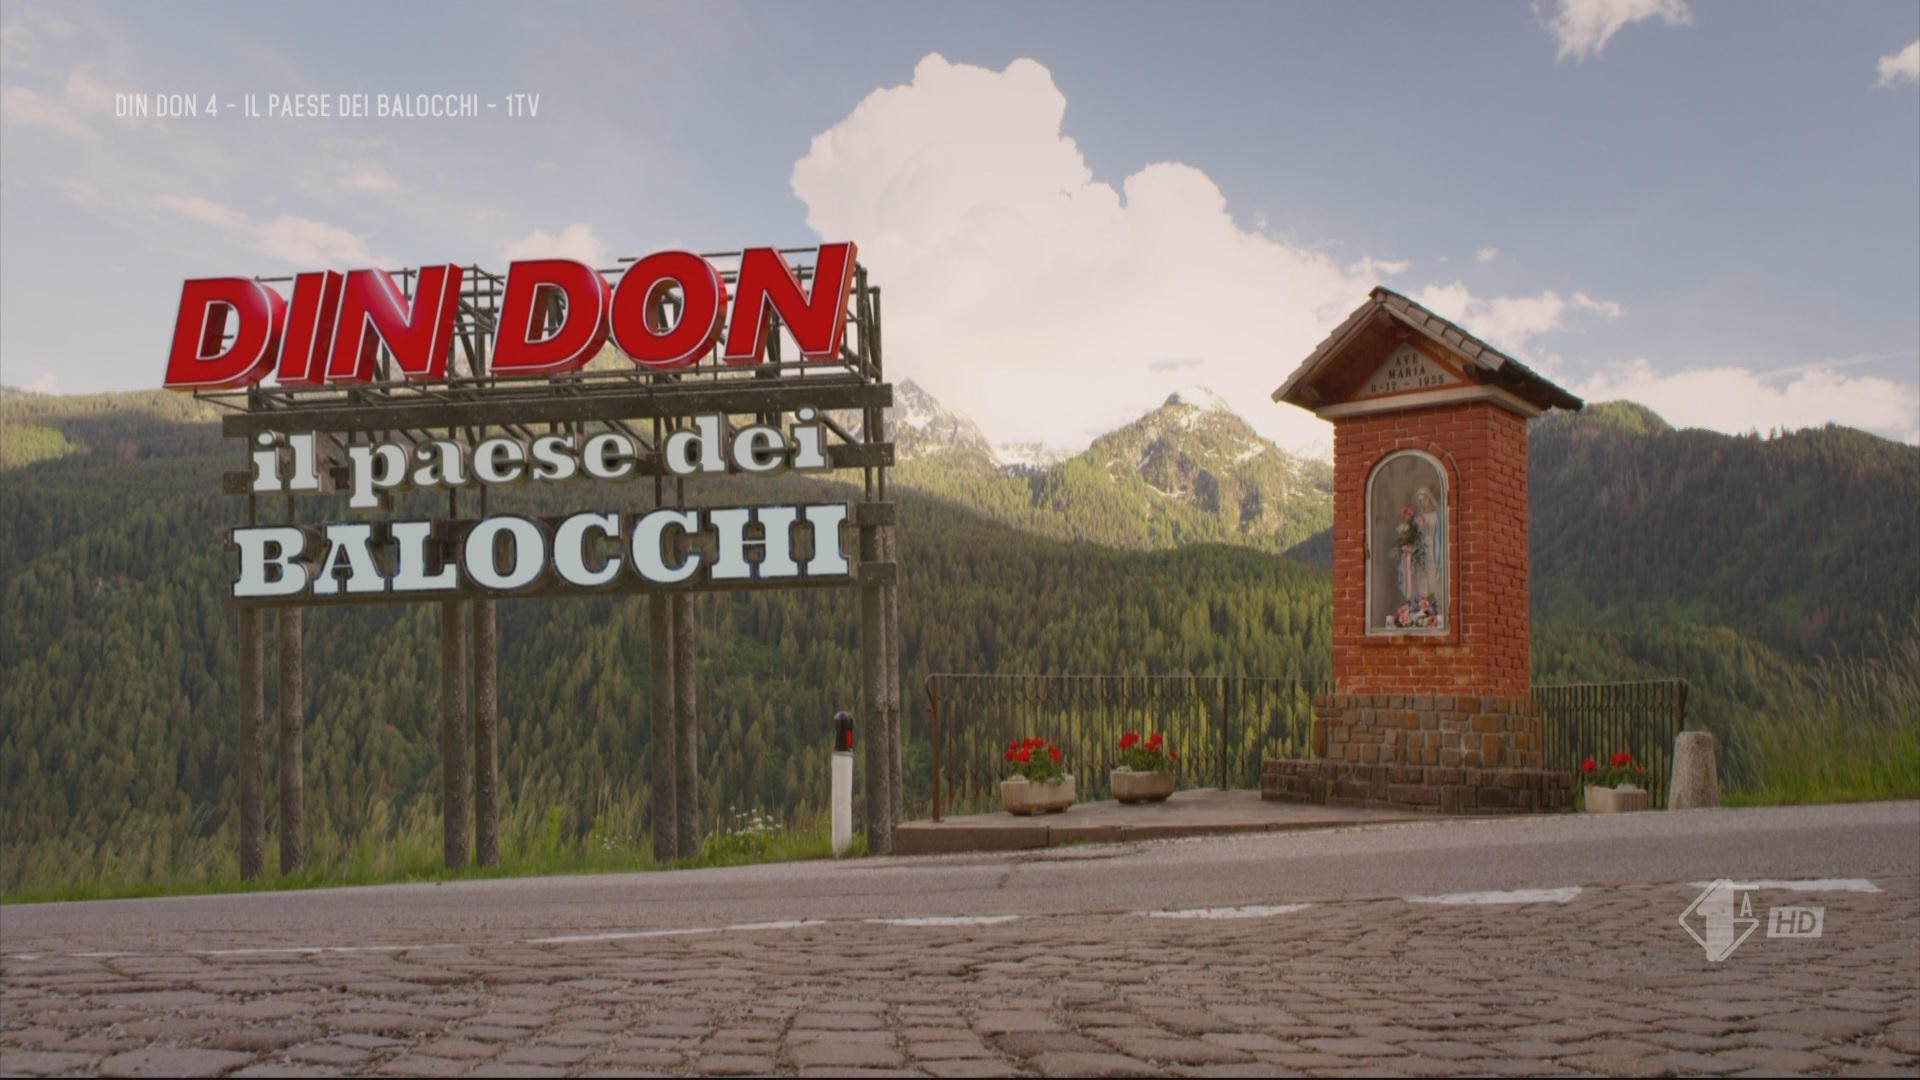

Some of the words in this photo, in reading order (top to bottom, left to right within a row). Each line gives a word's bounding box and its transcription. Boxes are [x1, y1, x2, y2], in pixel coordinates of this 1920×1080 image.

[163, 262, 463, 390] DIN
[490, 240, 856, 375] DON
[1394, 352, 1419, 367] AVE
[1388, 365, 1426, 379] MARIA
[252, 430, 322, 491] il
[347, 430, 640, 509] paese
[664, 408, 827, 473] dei
[232, 502, 851, 598] BALOCCHI
